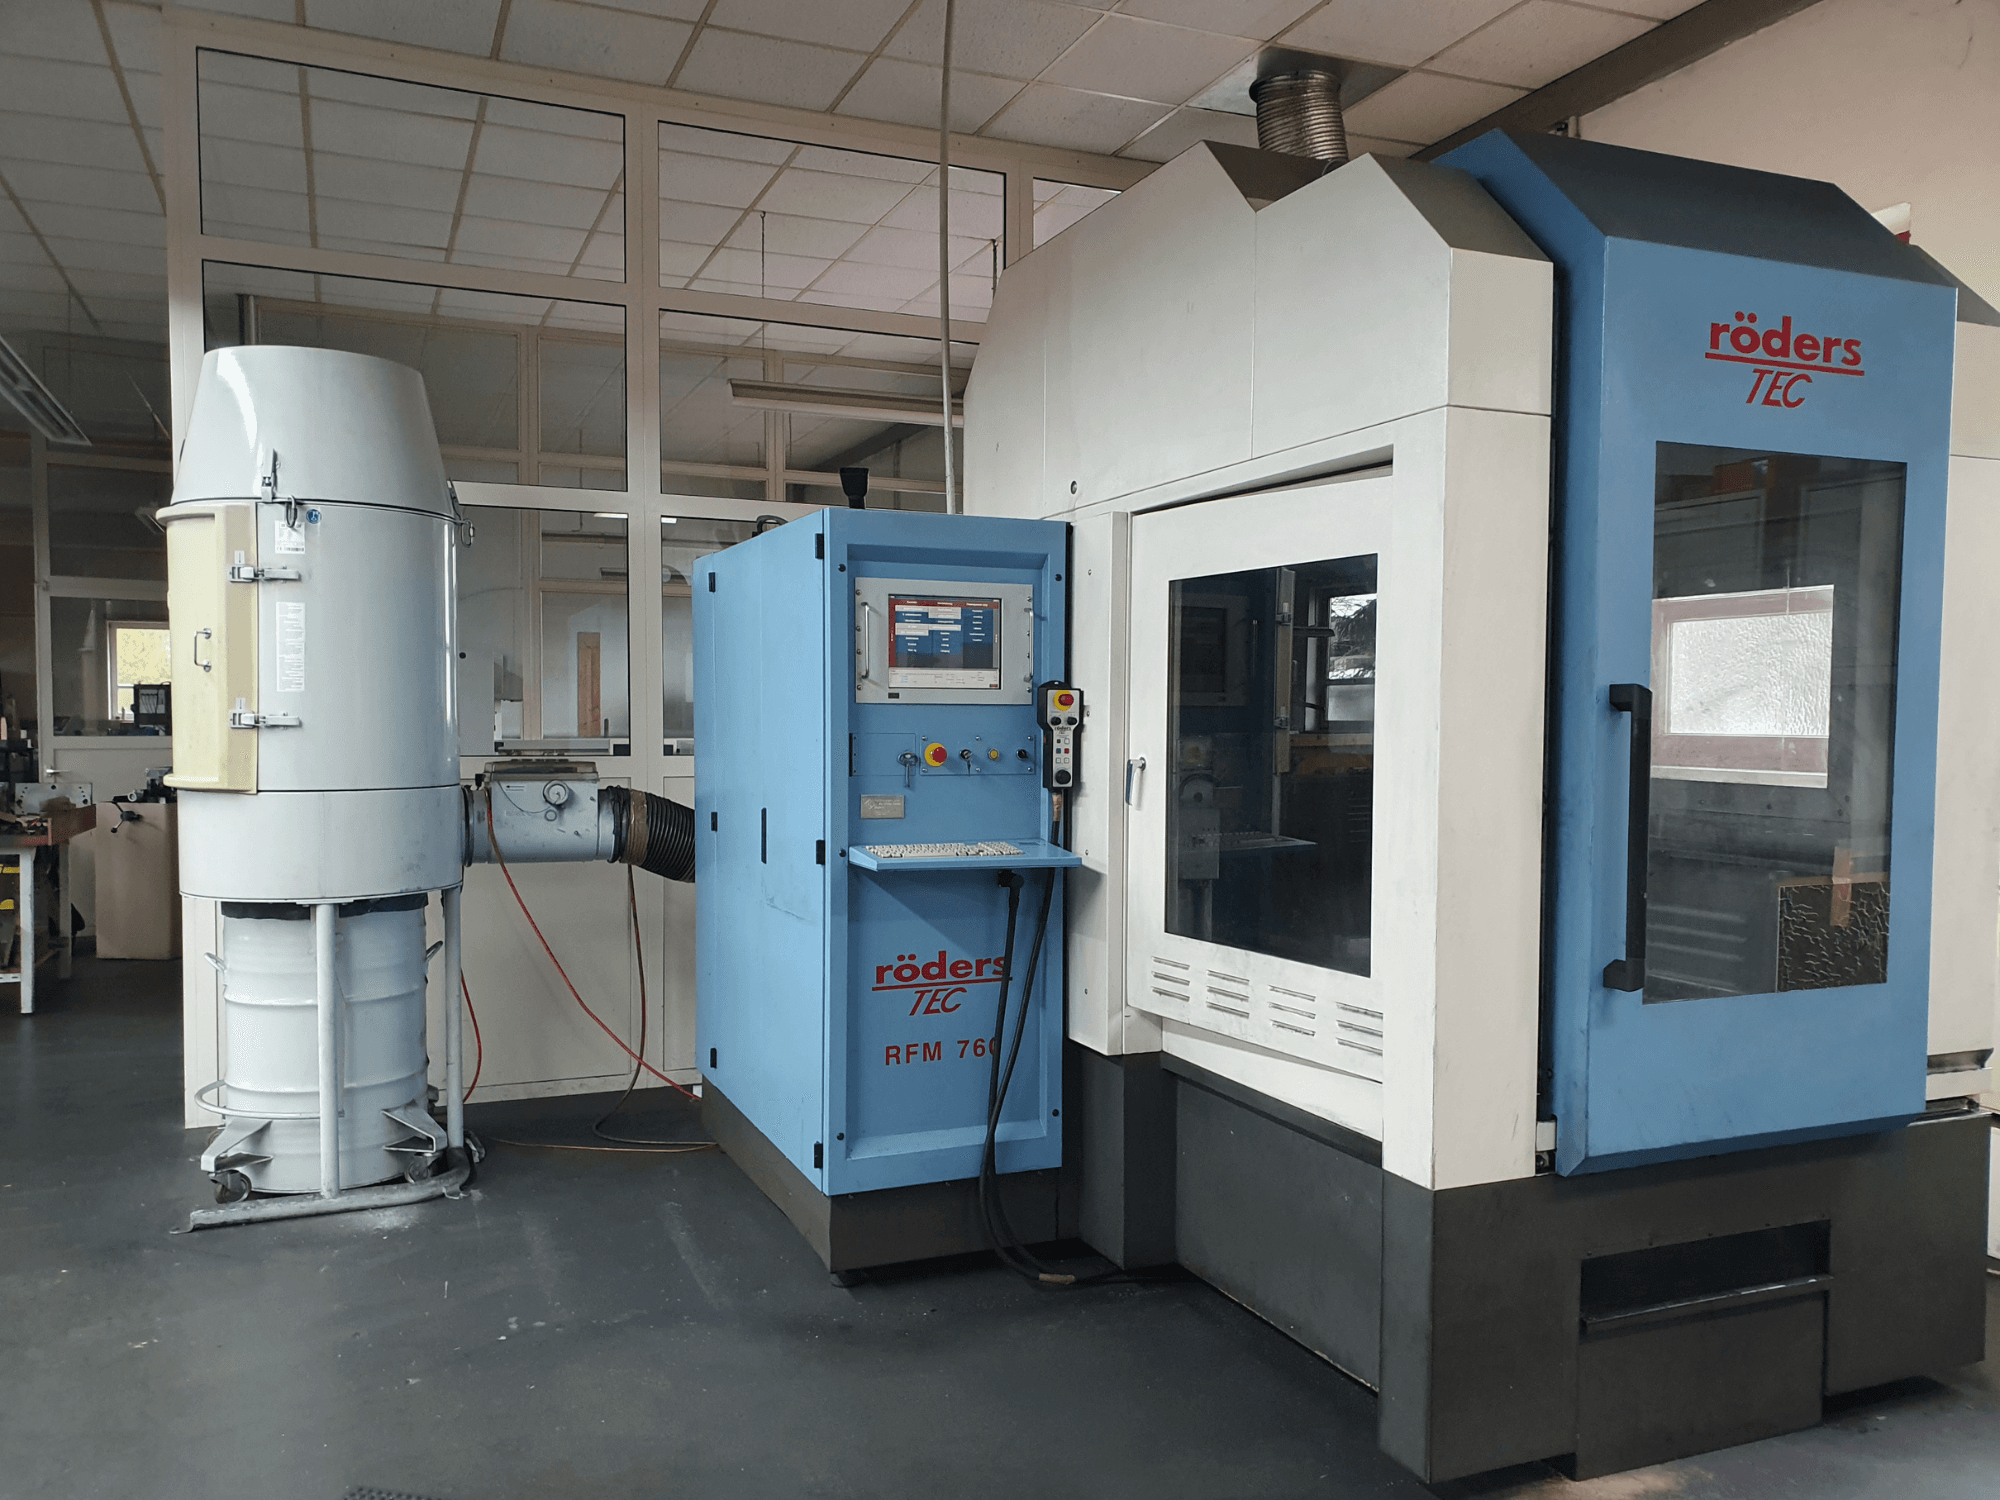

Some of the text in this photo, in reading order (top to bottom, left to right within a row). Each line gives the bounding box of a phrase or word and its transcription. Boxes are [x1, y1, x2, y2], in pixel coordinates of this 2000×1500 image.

[1710, 311, 1862, 367] röders
[1746, 368, 1813, 409] TEC
[876, 950, 1005, 984] röders
[909, 987, 967, 1016] TEC
[885, 1041, 942, 1066] RFM
